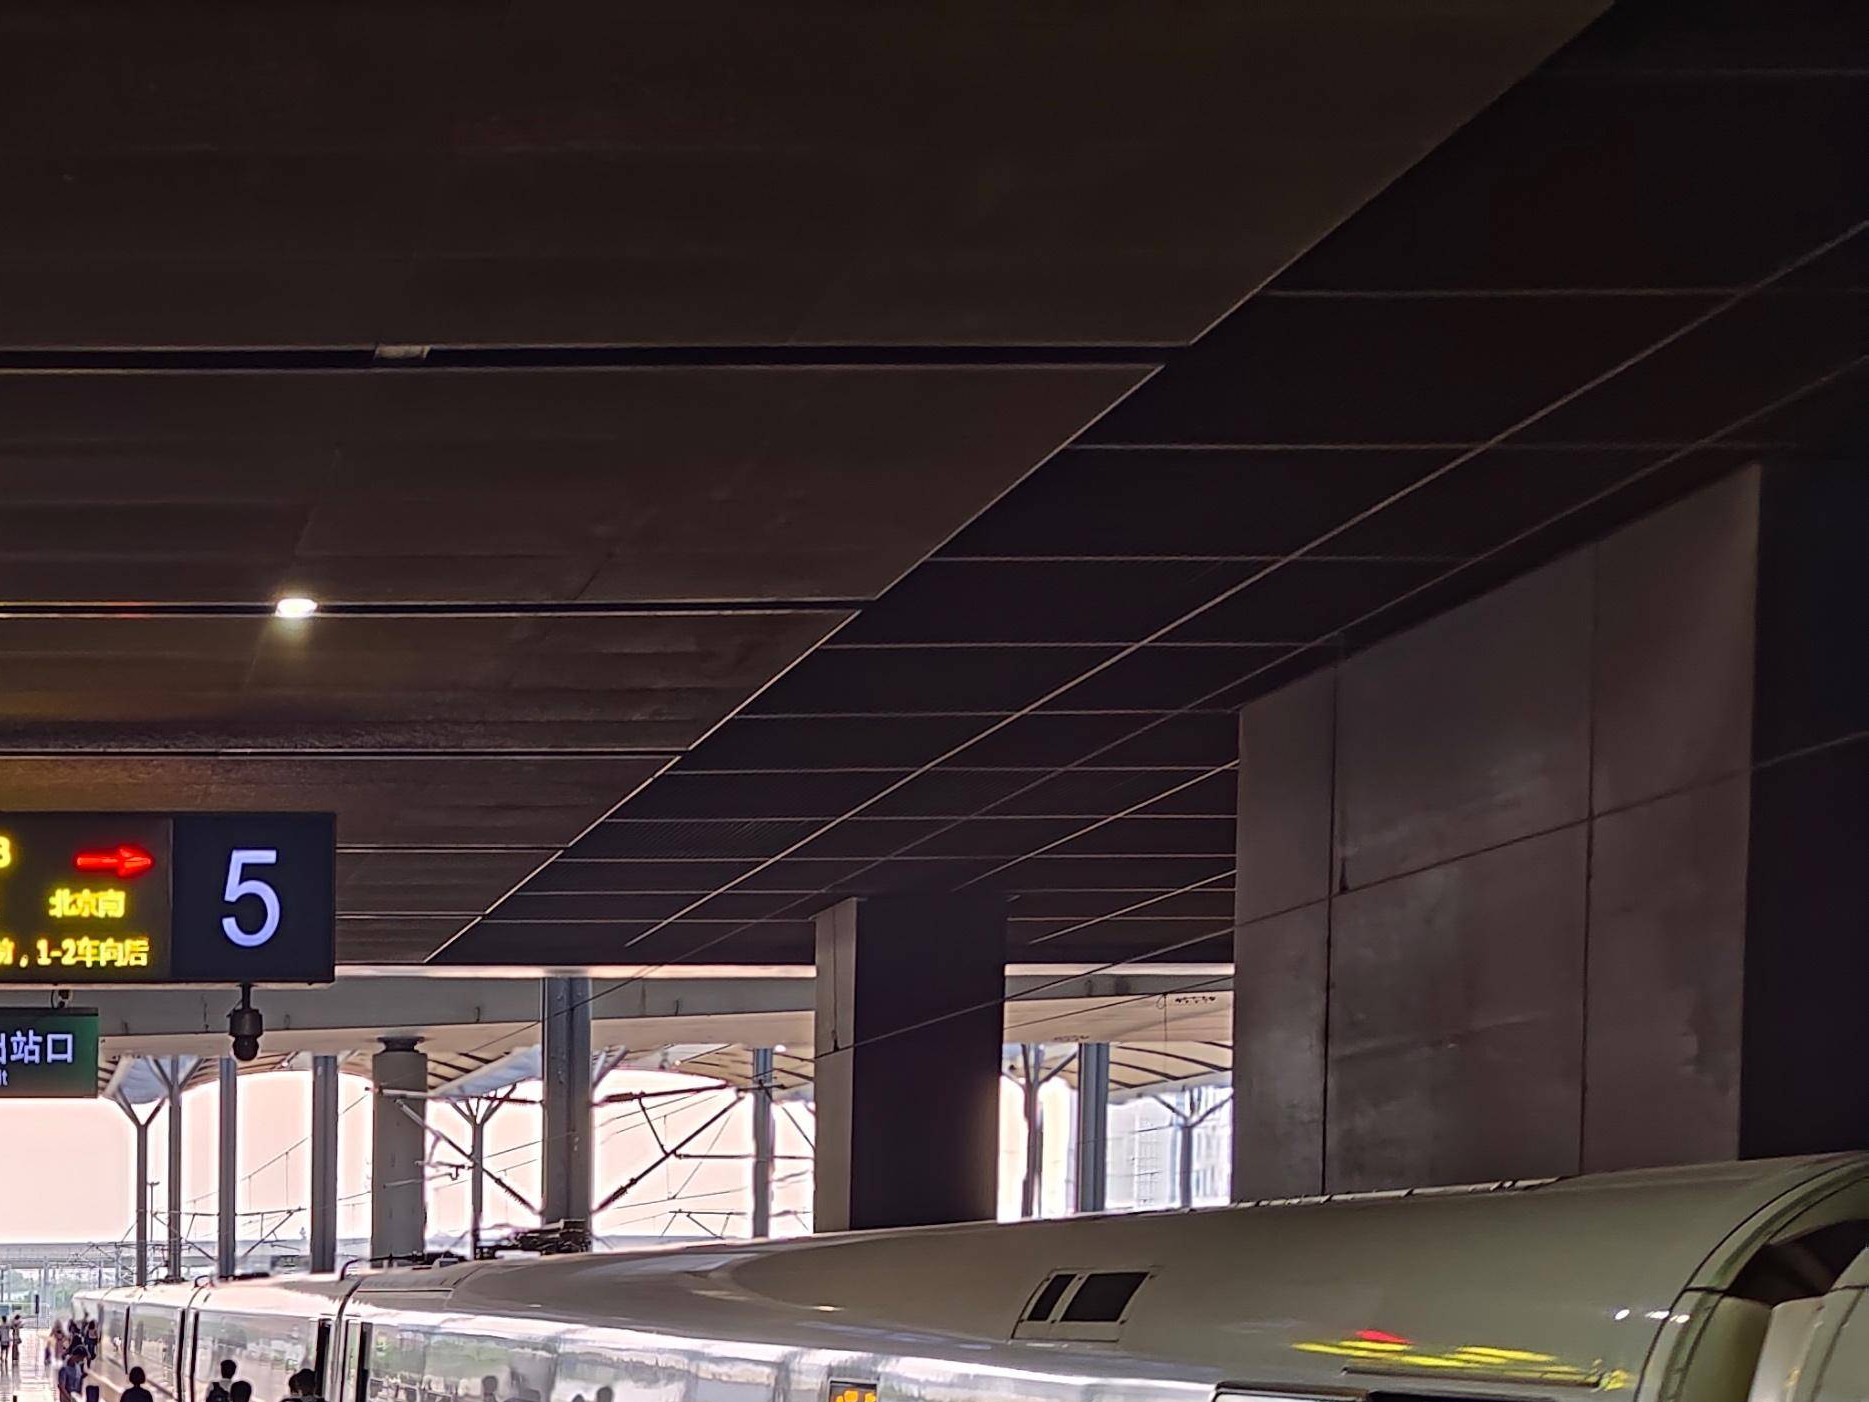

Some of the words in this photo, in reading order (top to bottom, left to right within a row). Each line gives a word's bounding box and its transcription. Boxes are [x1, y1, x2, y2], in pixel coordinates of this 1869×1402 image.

[48, 888, 127, 918] 北京南
[221, 849, 281, 947] 5
